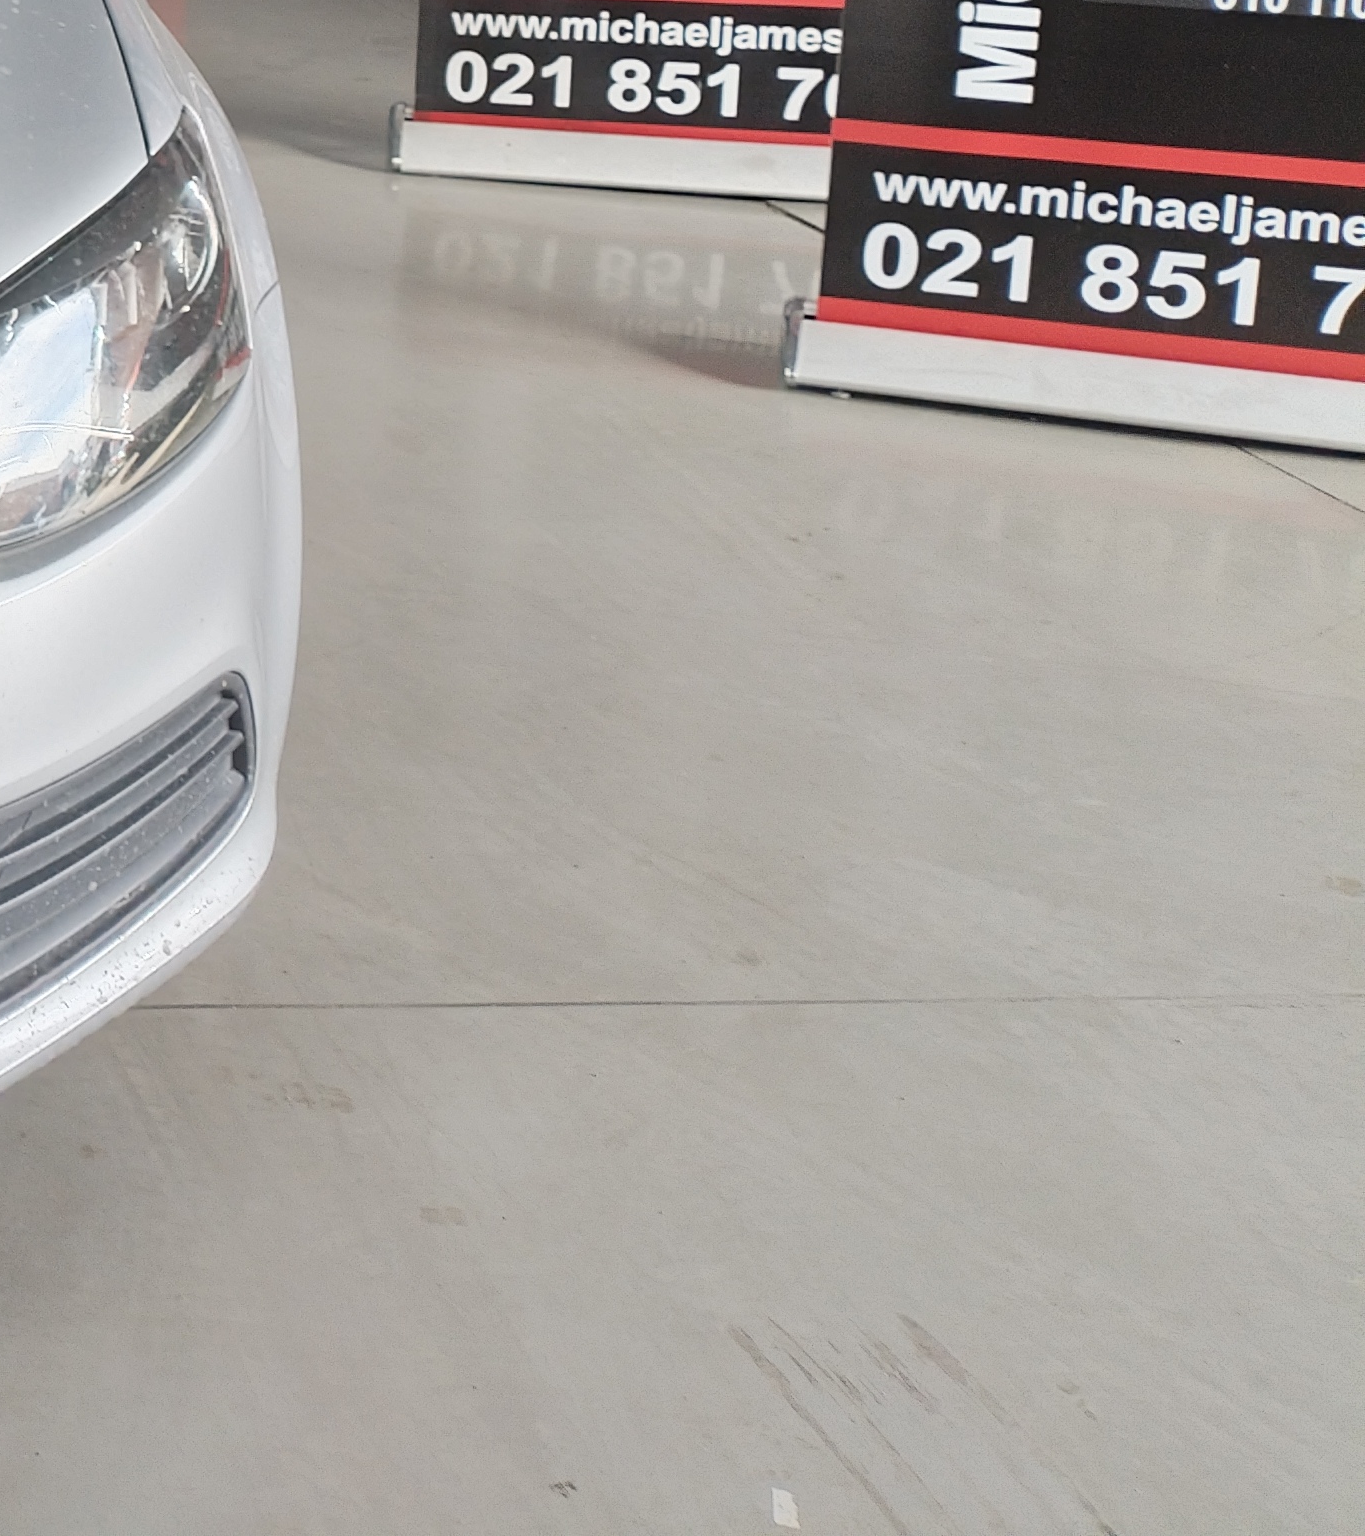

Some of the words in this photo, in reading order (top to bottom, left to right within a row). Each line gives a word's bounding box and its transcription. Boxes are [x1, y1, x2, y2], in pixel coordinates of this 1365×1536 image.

[445, 50, 573, 108] 021
[606, 57, 741, 118] 851
[862, 222, 1035, 305] 021
[1080, 243, 1262, 328] 851
